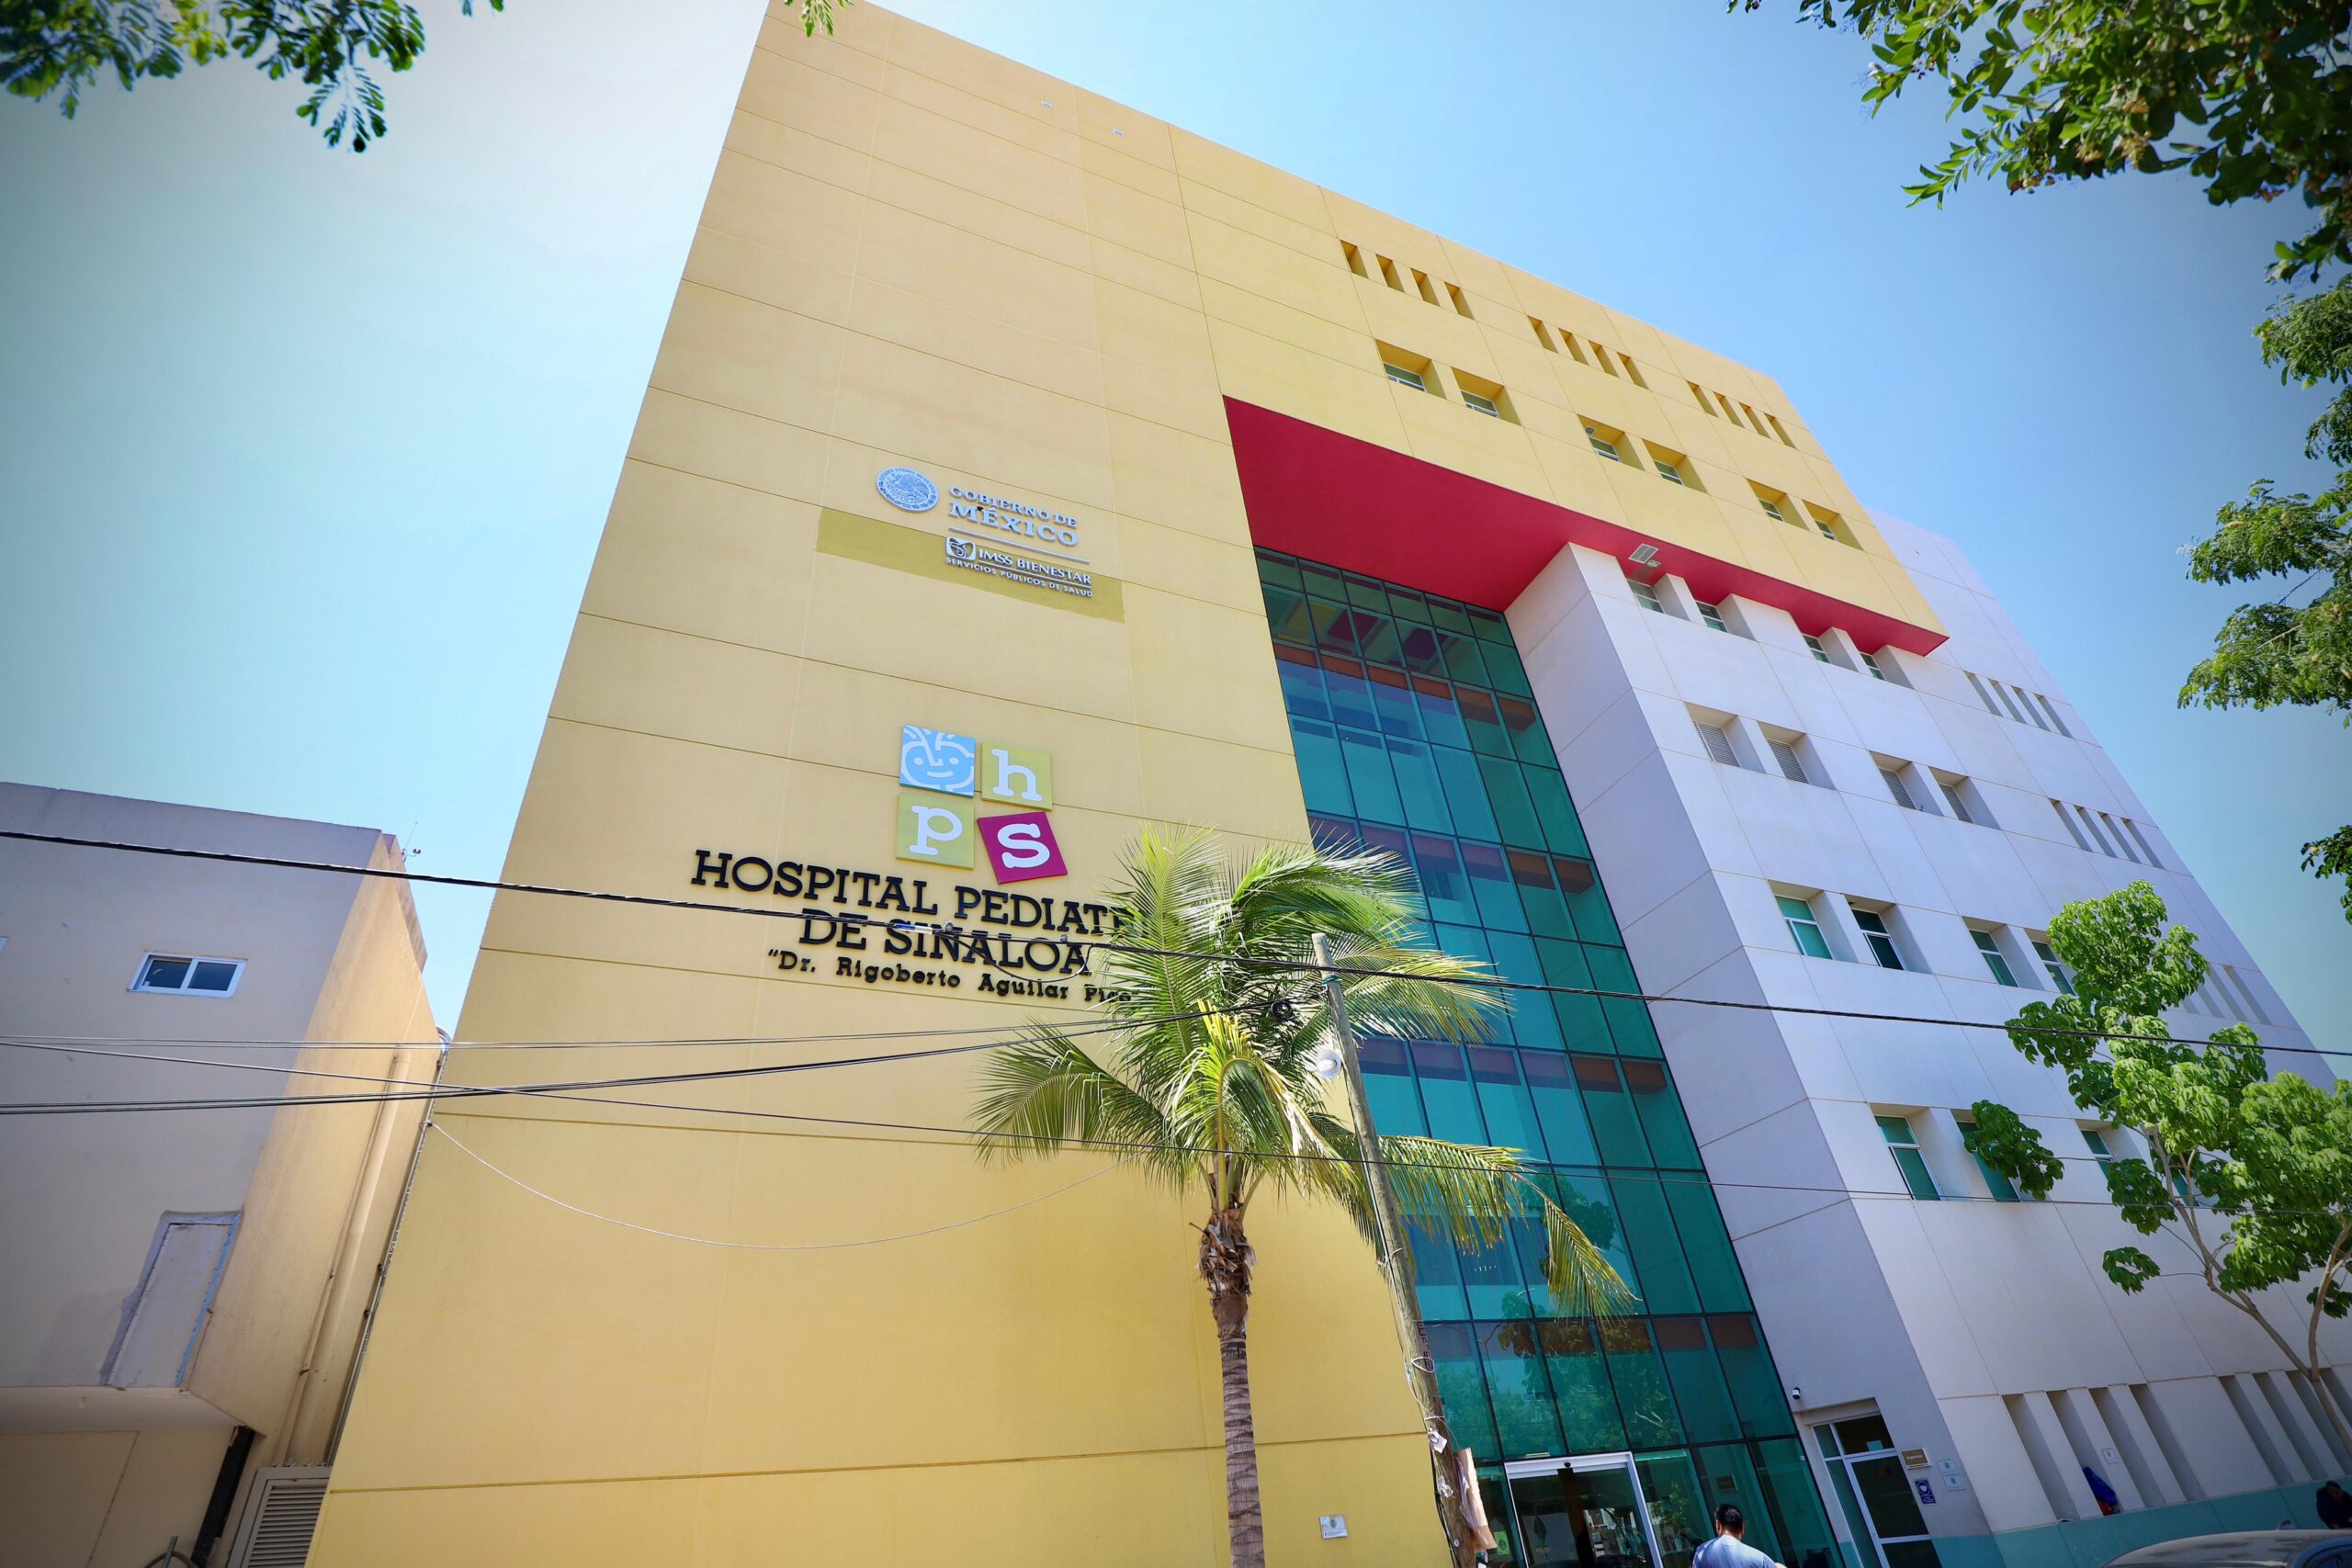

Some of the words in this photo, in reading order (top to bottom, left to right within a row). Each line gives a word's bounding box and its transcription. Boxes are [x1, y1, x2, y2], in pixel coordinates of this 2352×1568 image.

[948, 500, 1079, 547] MÉXICO
[949, 486, 1051, 522] GOBIERNO
[1054, 513, 1078, 529] DE
[945, 557, 997, 575] SERVICIOS
[1049, 581, 1061, 591] DE
[1064, 585, 1093, 598] SALUD
[978, 548, 1013, 566] IMSS
[1016, 558, 1091, 584] BIENESTAR
[991, 749, 1043, 802] h
[909, 805, 963, 856] p
[691, 850, 938, 915] HOSPITAL
[799, 908, 868, 950] DE
[884, 918, 1091, 976] SINALOA
[836, 956, 961, 987] Rigoberto
[978, 974, 1069, 999] Aguilar
